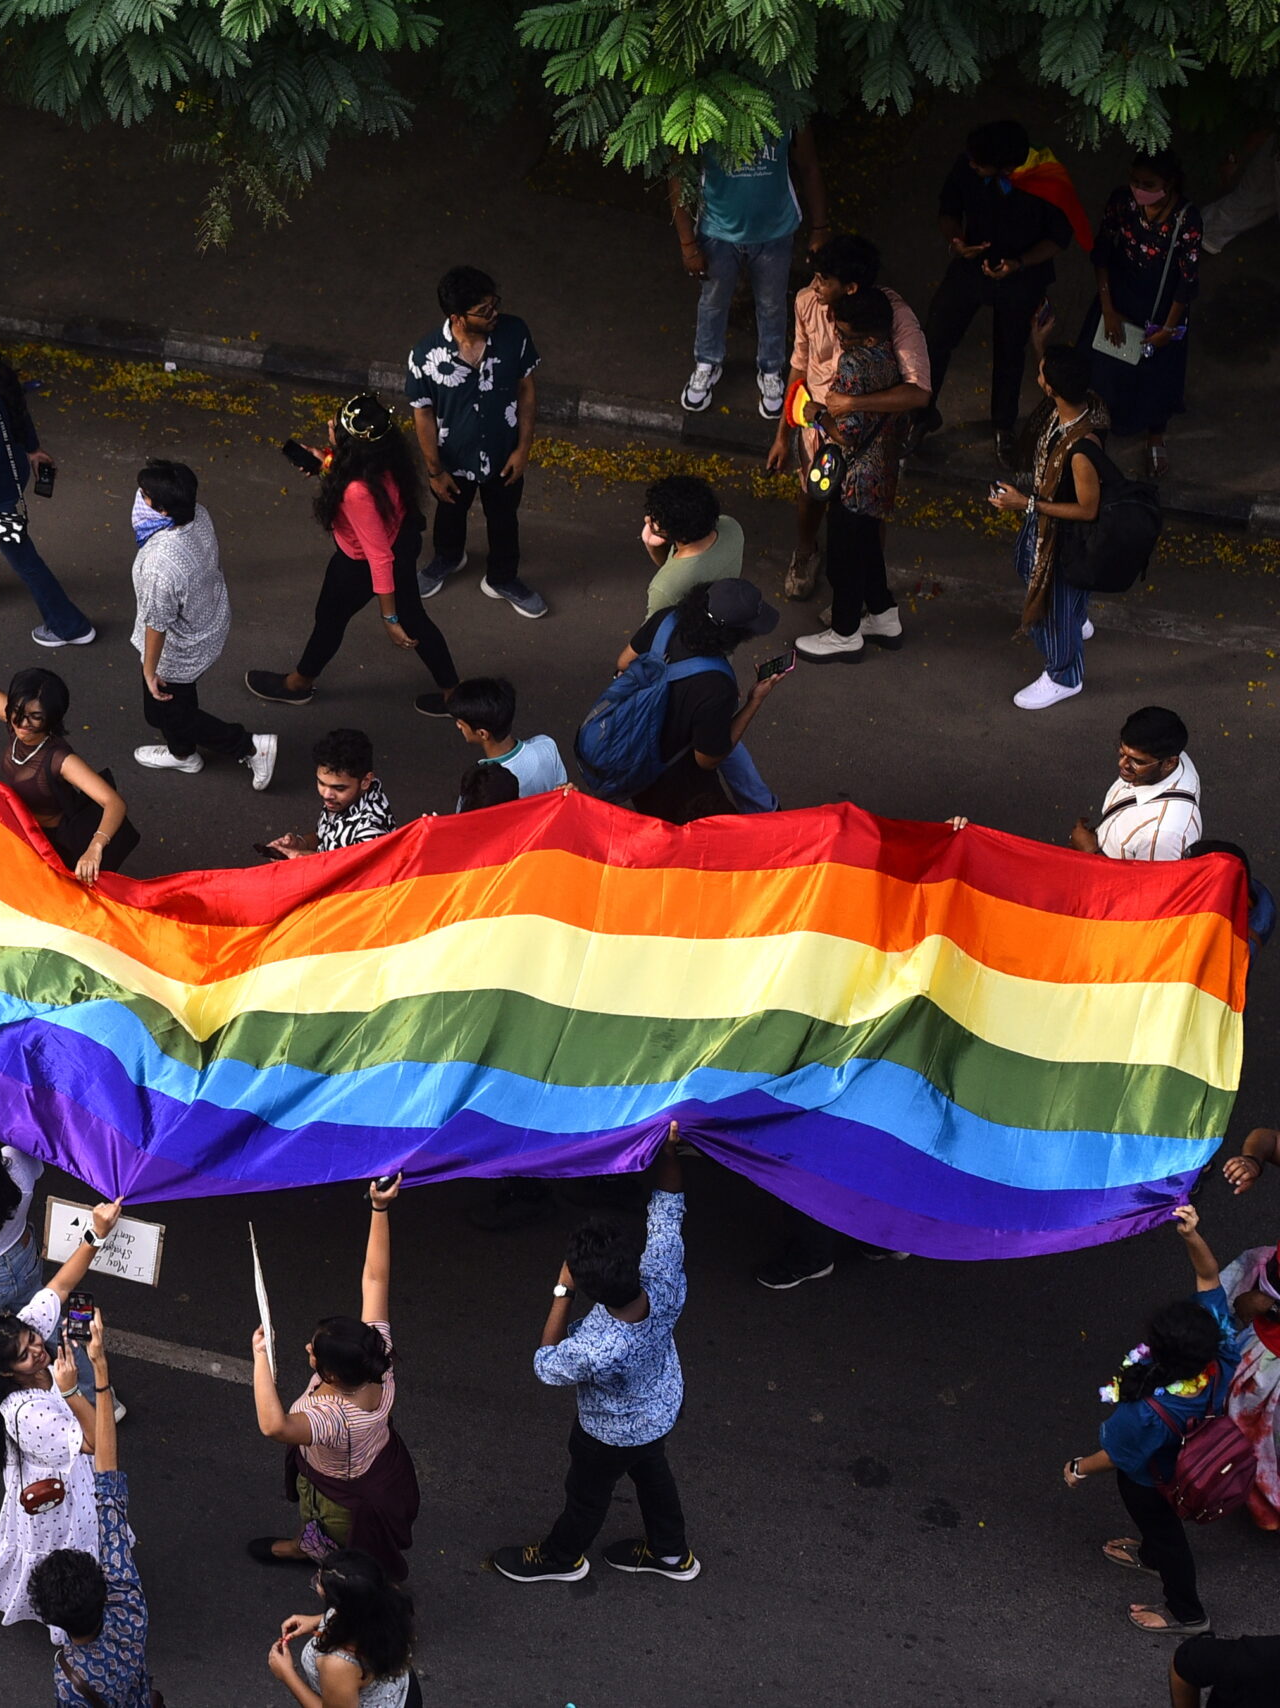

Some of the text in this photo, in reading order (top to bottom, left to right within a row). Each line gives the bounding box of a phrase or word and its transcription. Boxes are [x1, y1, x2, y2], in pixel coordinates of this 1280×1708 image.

[64, 1233, 73, 1241] I
[94, 1251, 144, 1276] I May b
